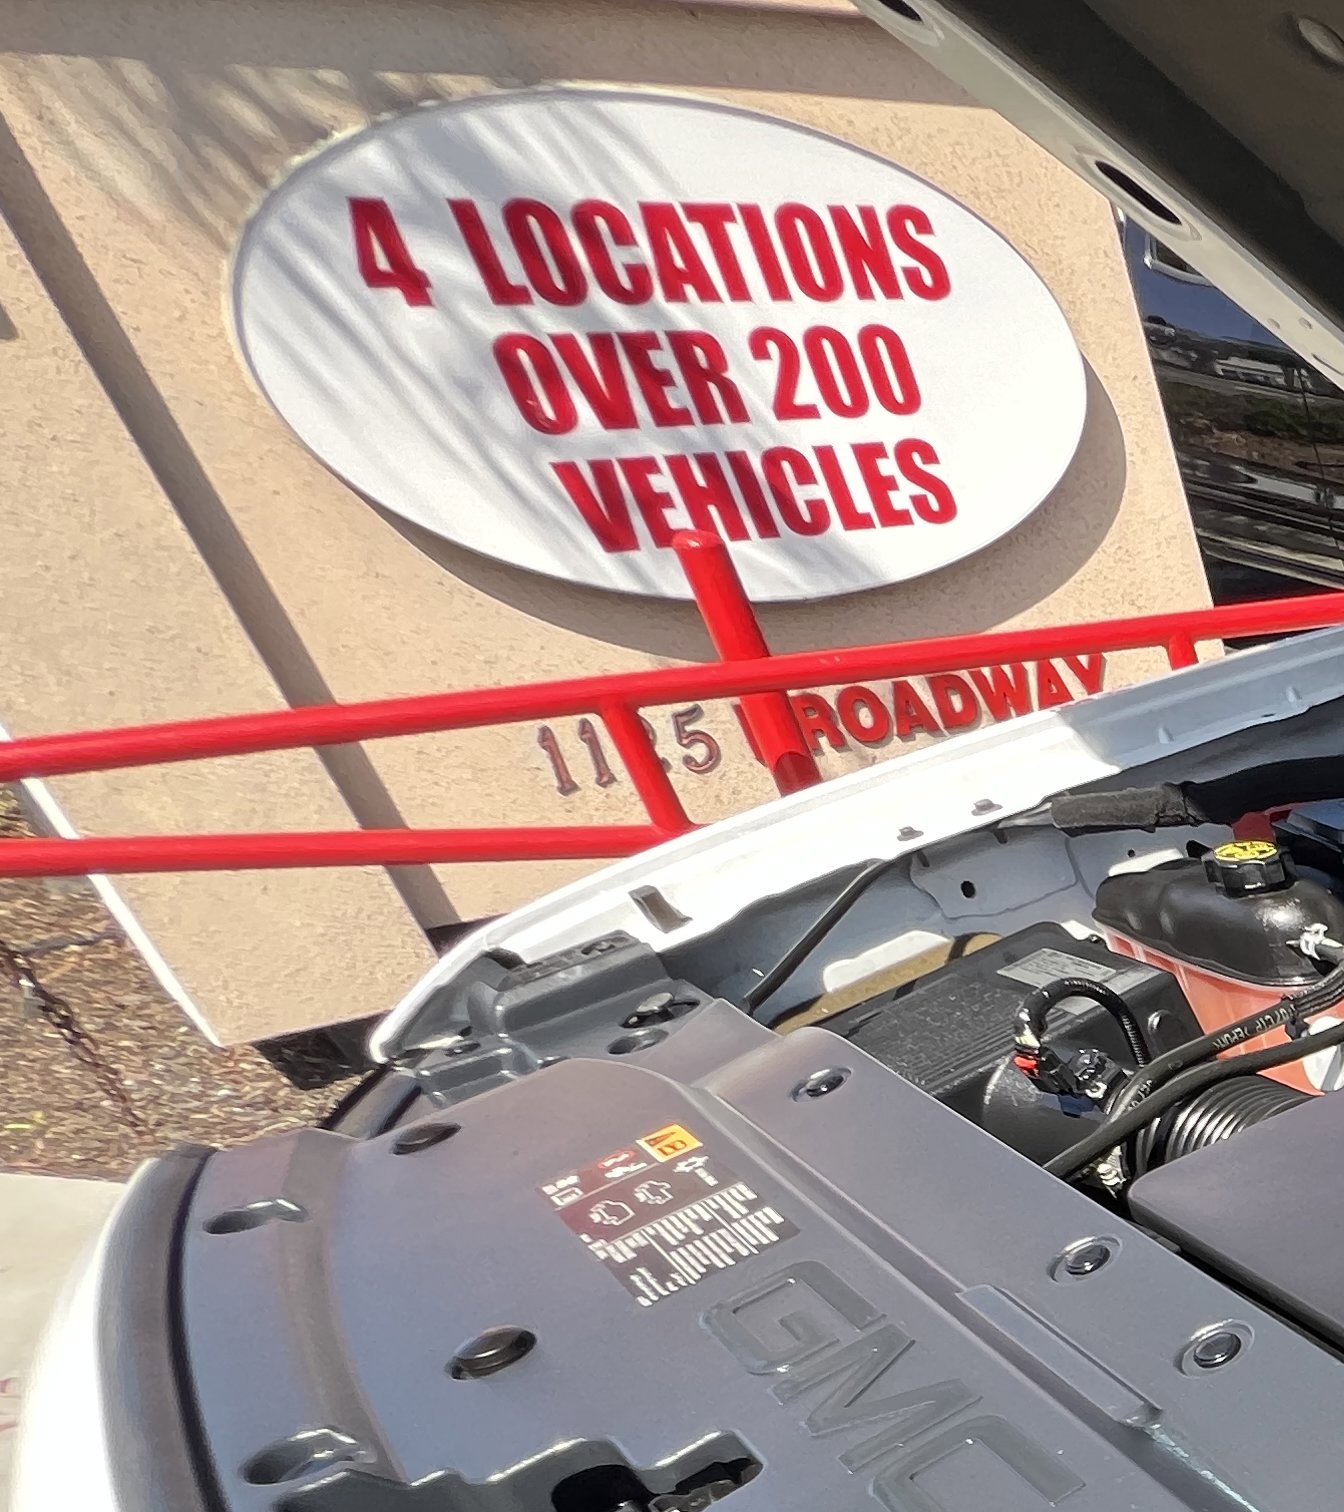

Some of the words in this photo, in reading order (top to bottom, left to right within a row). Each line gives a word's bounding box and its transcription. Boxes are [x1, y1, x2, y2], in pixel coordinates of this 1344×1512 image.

[348, 196, 434, 307] 4
[448, 197, 952, 306] LOCATIONS
[492, 331, 750, 435] OVER
[747, 324, 922, 421] 200
[552, 437, 958, 554] VEHICLES
[537, 703, 722, 796] 115
[734, 653, 1105, 768] ROADWAY
